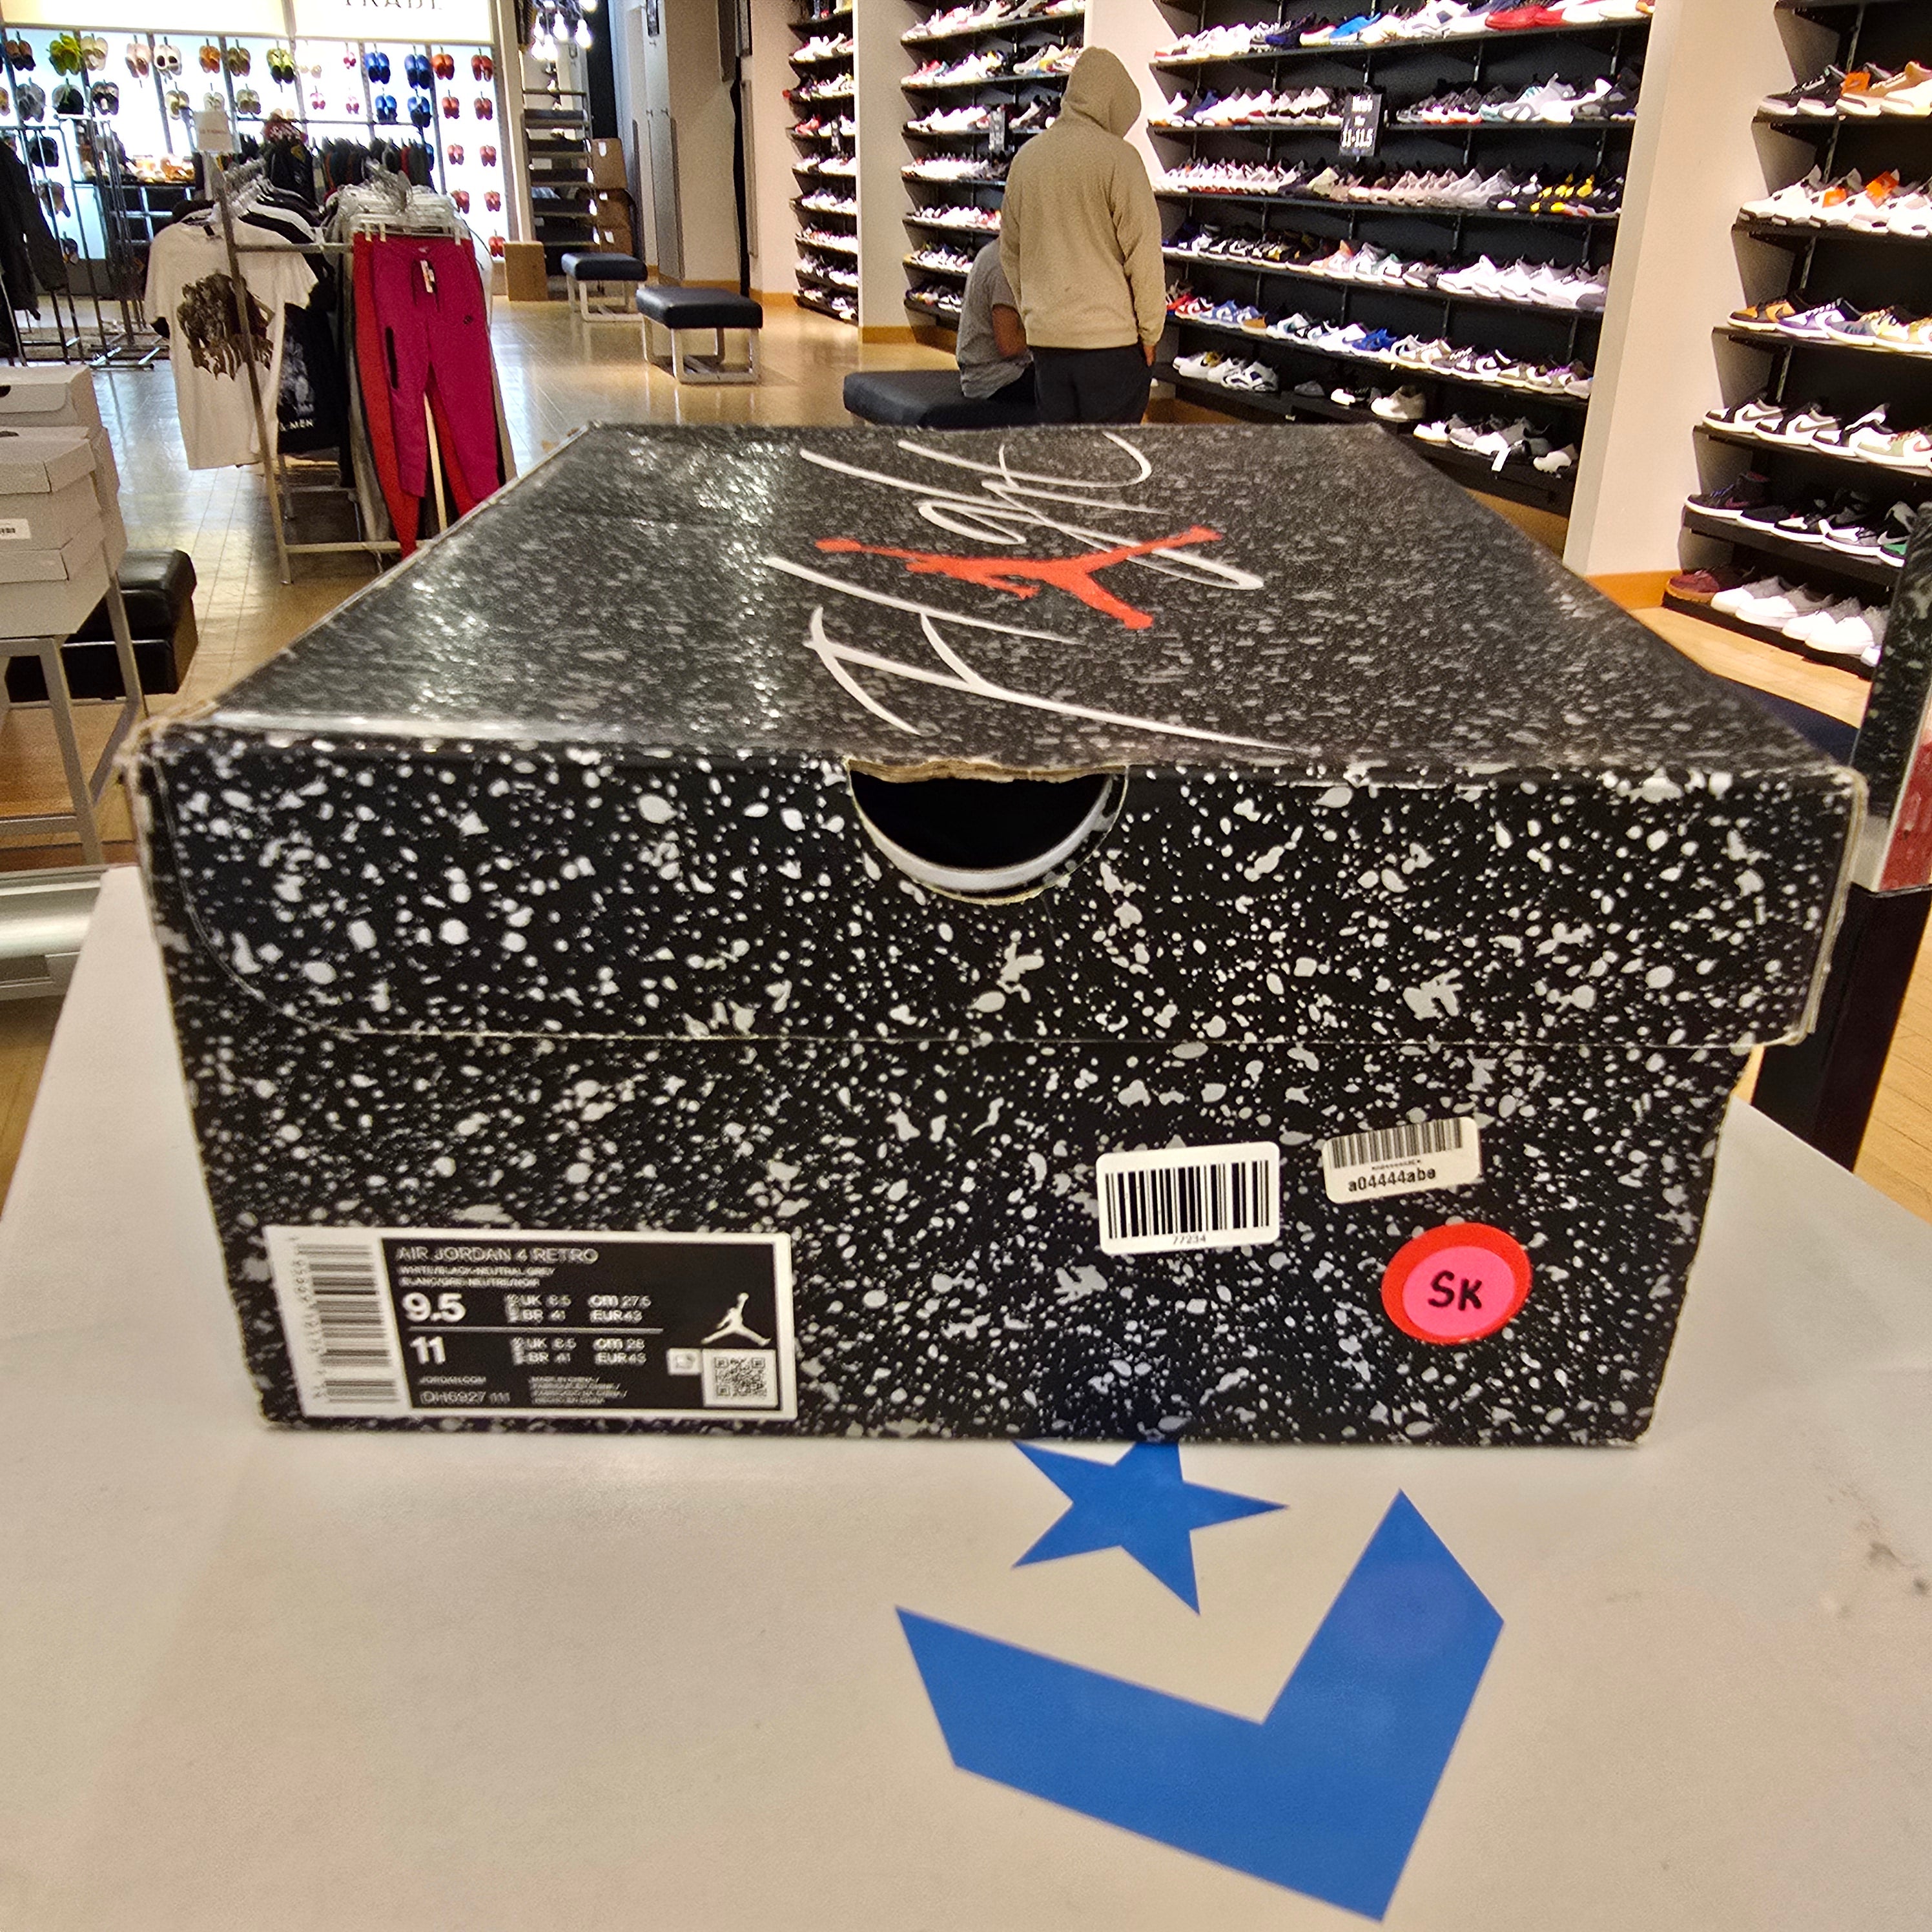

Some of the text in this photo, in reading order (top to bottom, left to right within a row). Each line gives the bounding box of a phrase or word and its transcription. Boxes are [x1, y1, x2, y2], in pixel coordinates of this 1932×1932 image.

[396, 1246, 599, 1264] AIR JORDAN 4 RETRO
[402, 1292, 466, 1322] 9.5
[409, 1336, 446, 1365] 11
